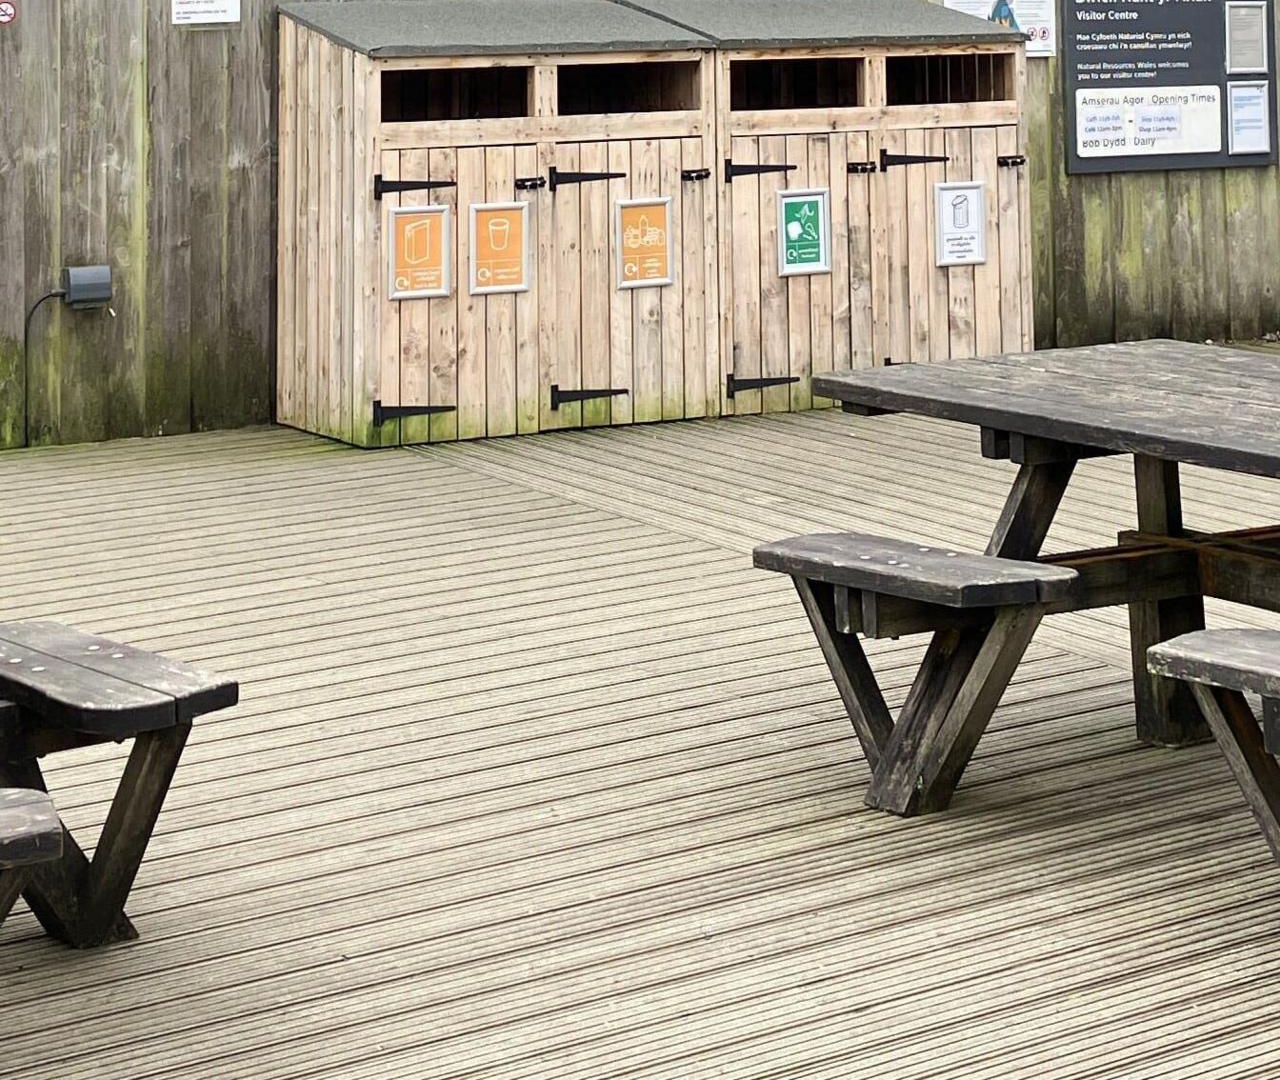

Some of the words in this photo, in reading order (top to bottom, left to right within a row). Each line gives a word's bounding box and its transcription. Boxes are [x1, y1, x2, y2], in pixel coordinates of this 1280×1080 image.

[1076, 10, 1106, 20] Visitor
[1108, 10, 1139, 20] Centre
[1081, 96, 1120, 106] Amserau
[1122, 96, 1144, 106] Agor
[1151, 94, 1188, 104] Opening
[1191, 93, 1216, 103] Times
